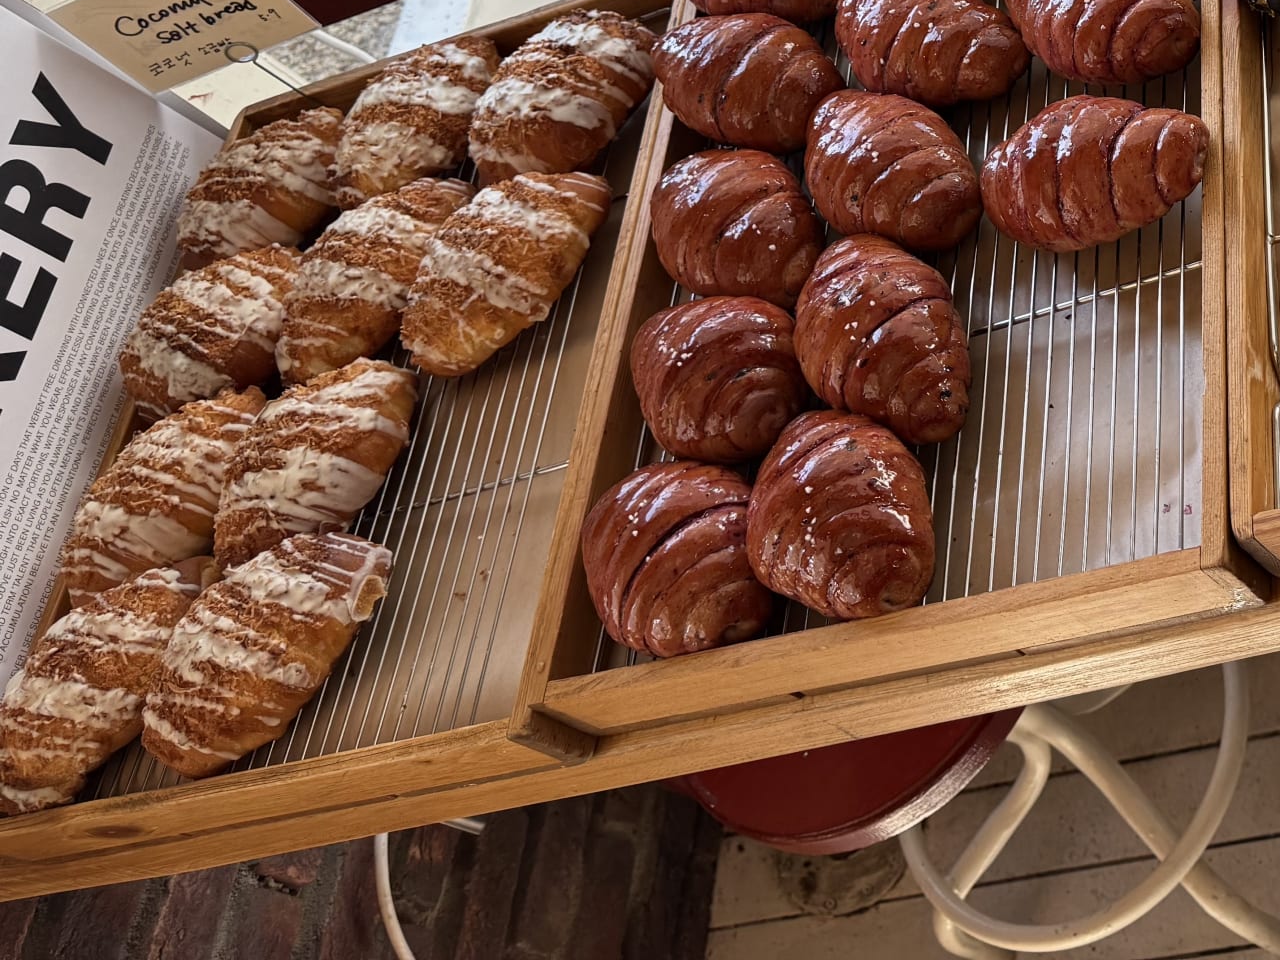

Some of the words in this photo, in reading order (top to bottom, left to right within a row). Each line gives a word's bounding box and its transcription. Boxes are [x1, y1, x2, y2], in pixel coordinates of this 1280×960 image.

[156, 23, 199, 45] salt
[159, 139, 172, 158] SPOT
[141, 161, 152, 176] ARE
[154, 157, 165, 171] THE
[132, 175, 147, 201] HANDS
[149, 171, 159, 183] ON
[124, 200, 137, 220] YOUR
[128, 182, 155, 238] PERFORMANCES
[116, 229, 126, 239] AS
[120, 220, 129, 229] IF
[138, 224, 150, 241] JUST
[107, 239, 121, 262] TEXTS
[111, 237, 134, 281] IMPROMPTU
[126, 254, 138, 271] THAT
[93, 262, 112, 296] FLOWING
[106, 280, 116, 293] OR
[121, 271, 132, 284] OR
[4, 472, 15, 485] OF
[10, 450, 24, 471] DAYS
[19, 429, 32, 449] THAT
[27, 393, 47, 428] WEREN'T
[51, 333, 72, 371] DRAWING
[66, 313, 80, 334] WITH
[74, 268, 99, 314] CONNECTED
[93, 247, 107, 269] LINES
[101, 237, 111, 248] AT
[114, 182, 133, 216] CREATING
[128, 147, 147, 183] DELICIOUS
[80, 297, 98, 329] WRITING
[105, 307, 117, 325] THIS
[97, 324, 110, 345] BEEN
[58, 330, 85, 384] EFFORTLESSLY
[77, 350, 88, 367] ANY
[85, 345, 102, 375] ALWAYS
[72, 368, 81, 377] IN
[76, 375, 90, 396] HAVE
[1, 590, 16, 615] TERM
[26, 530, 40, 552] THAT
[35, 498, 53, 531] PEOPLE
[48, 469, 64, 497] OFTEN
[80, 359, 108, 416] UNDOUBTEDLY
[103, 315, 125, 359] SOMETHING
[120, 293, 134, 315] MADE
[129, 271, 143, 293] FROM
[155, 206, 168, 225] DAILY
[54, 377, 78, 424] RESPONSES
[69, 396, 82, 415] AND
[29, 542, 48, 577] BELIEVE
[49, 512, 59, 526] AN
[80, 402, 103, 445] PERFECTLY
[132, 295, 145, 312] THAT
[139, 278, 151, 294] YOU
[39, 411, 52, 429] YOU
[60, 415, 74, 436] HAVE
[29, 430, 44, 454] WHAT
[43, 424, 59, 450] WITTY
[48, 436, 66, 468] ALWAYS
[16, 454, 34, 488] MATTER
[41, 468, 53, 486] YOU
[9, 489, 20, 503] NO
[35, 486, 46, 499] AS
[14, 495, 30, 522] EXACT
[24, 498, 41, 527] LIVING
[5, 522, 19, 544] INTO
[14, 528, 29, 551] BEEN
[6, 551, 20, 573] JUST
[22, 631, 34, 648] SEE
[29, 604, 44, 630] SUCH
